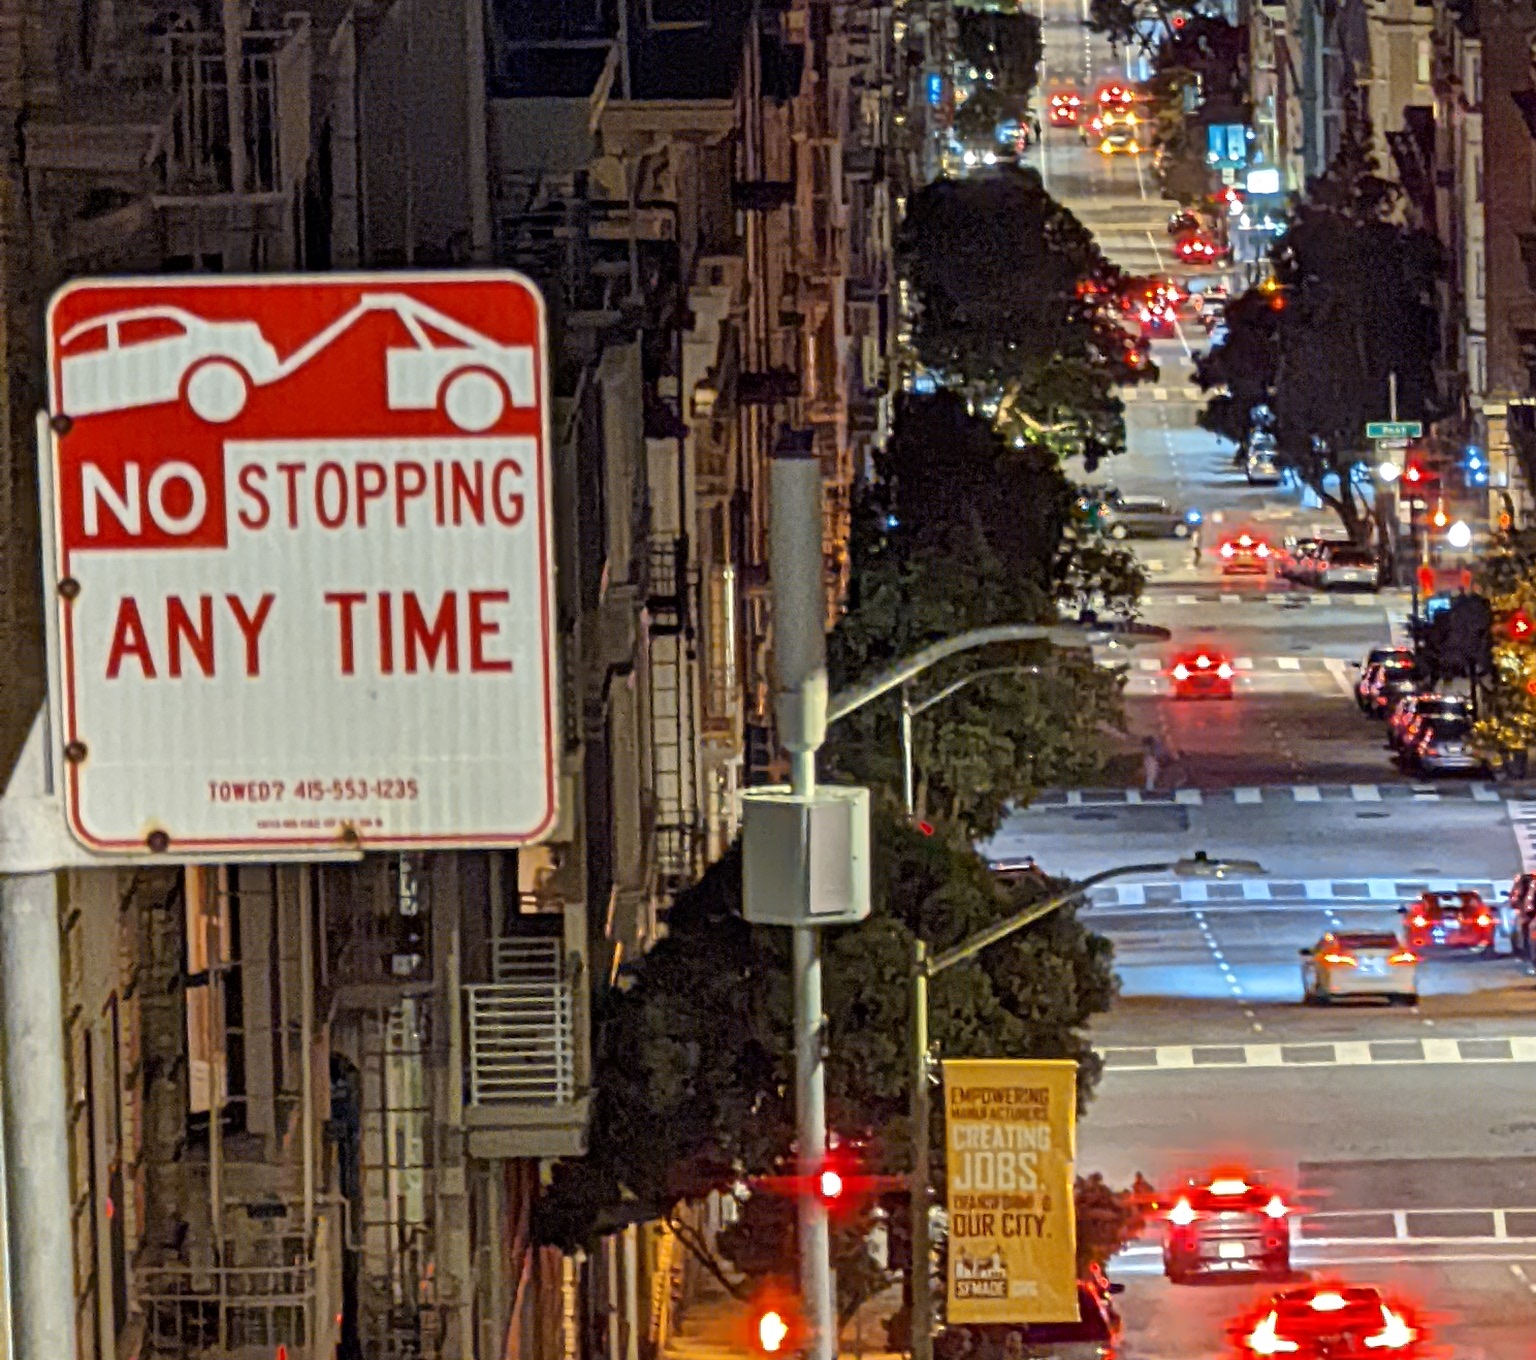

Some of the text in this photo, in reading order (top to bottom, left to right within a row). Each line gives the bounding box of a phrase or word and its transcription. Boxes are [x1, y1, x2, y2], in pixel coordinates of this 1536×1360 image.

[81, 459, 525, 536] NO STOPPING
[105, 590, 513, 680] ANY TIME
[208, 778, 419, 802] TOWED? 415-553-1235
[953, 1124, 1050, 1152] CREATING
[953, 1151, 1046, 1191] JOBS.
[953, 1213, 1052, 1238] OUR CITY.
